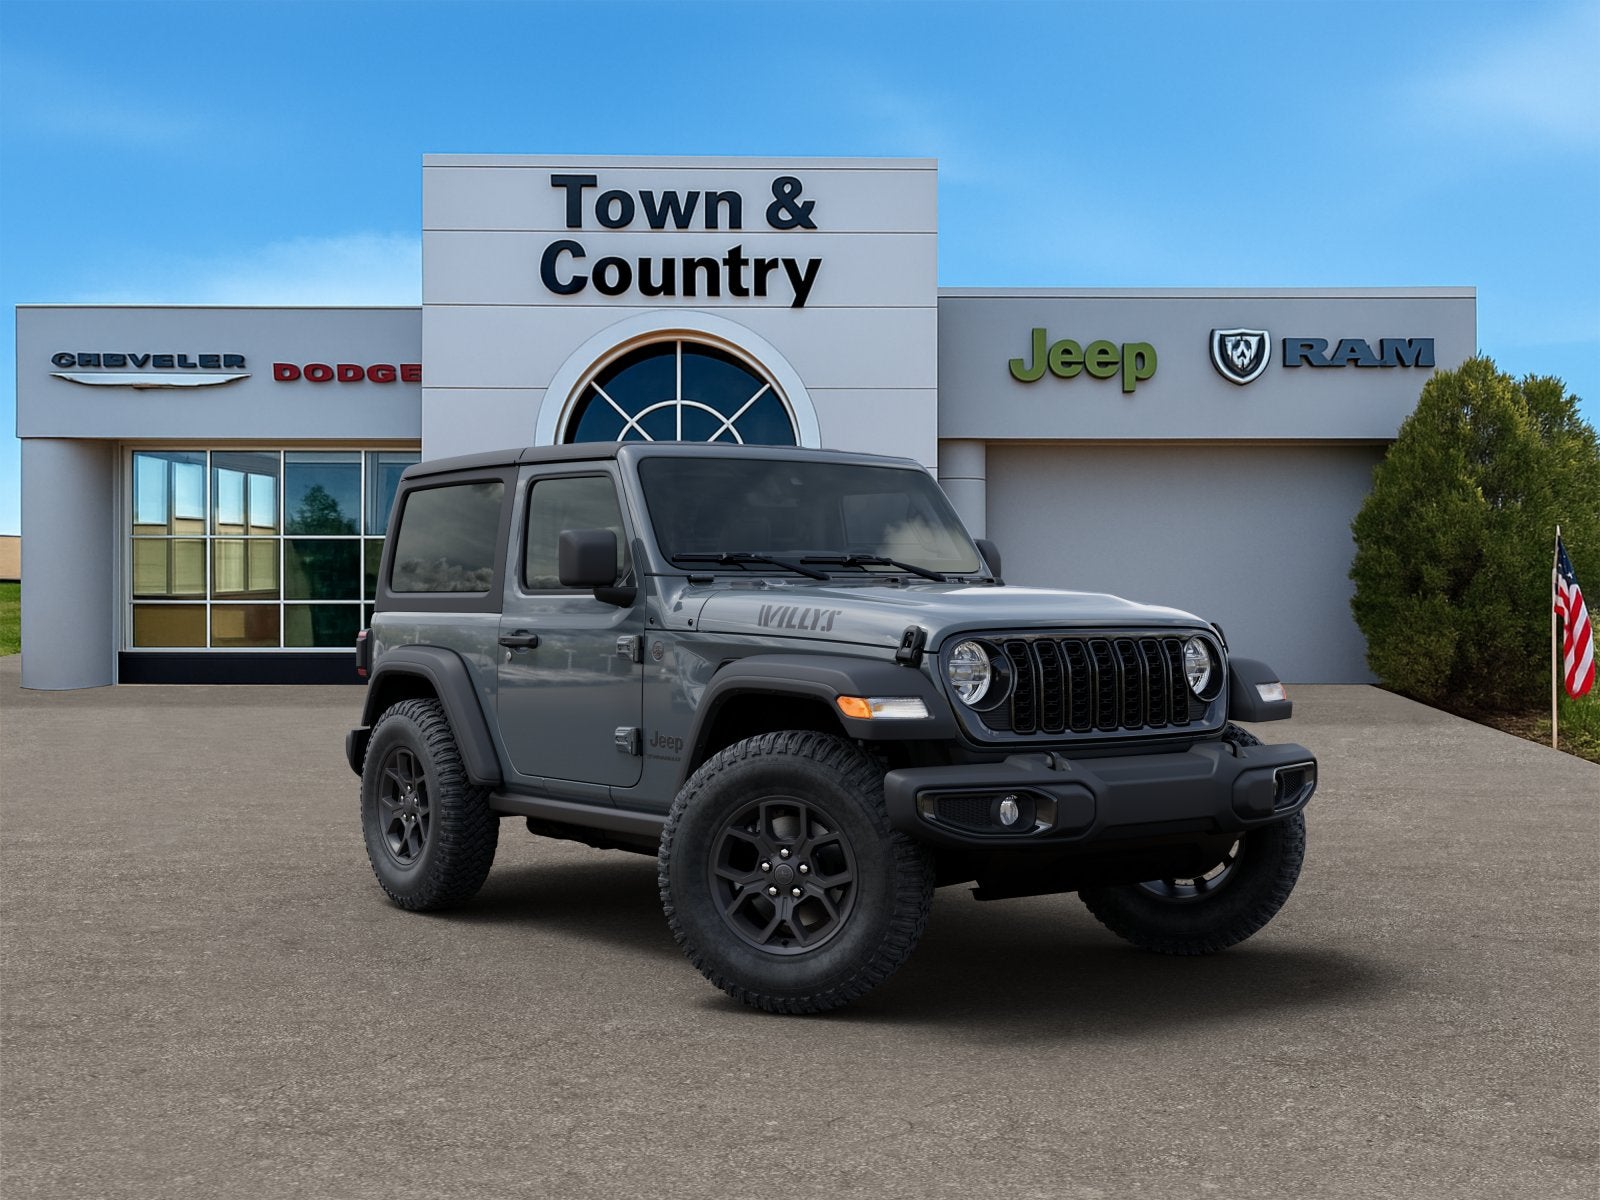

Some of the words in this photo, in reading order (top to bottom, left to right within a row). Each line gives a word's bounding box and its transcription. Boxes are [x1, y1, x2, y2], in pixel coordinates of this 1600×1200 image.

[550, 173, 743, 230] Town
[765, 175, 818, 231] &
[539, 239, 823, 308] Country
[1009, 327, 1157, 393] Jeep
[1282, 337, 1436, 368] RAM
[273, 363, 422, 383] DODGE
[757, 604, 843, 632] WILLYS
[649, 730, 684, 754] Jeep
